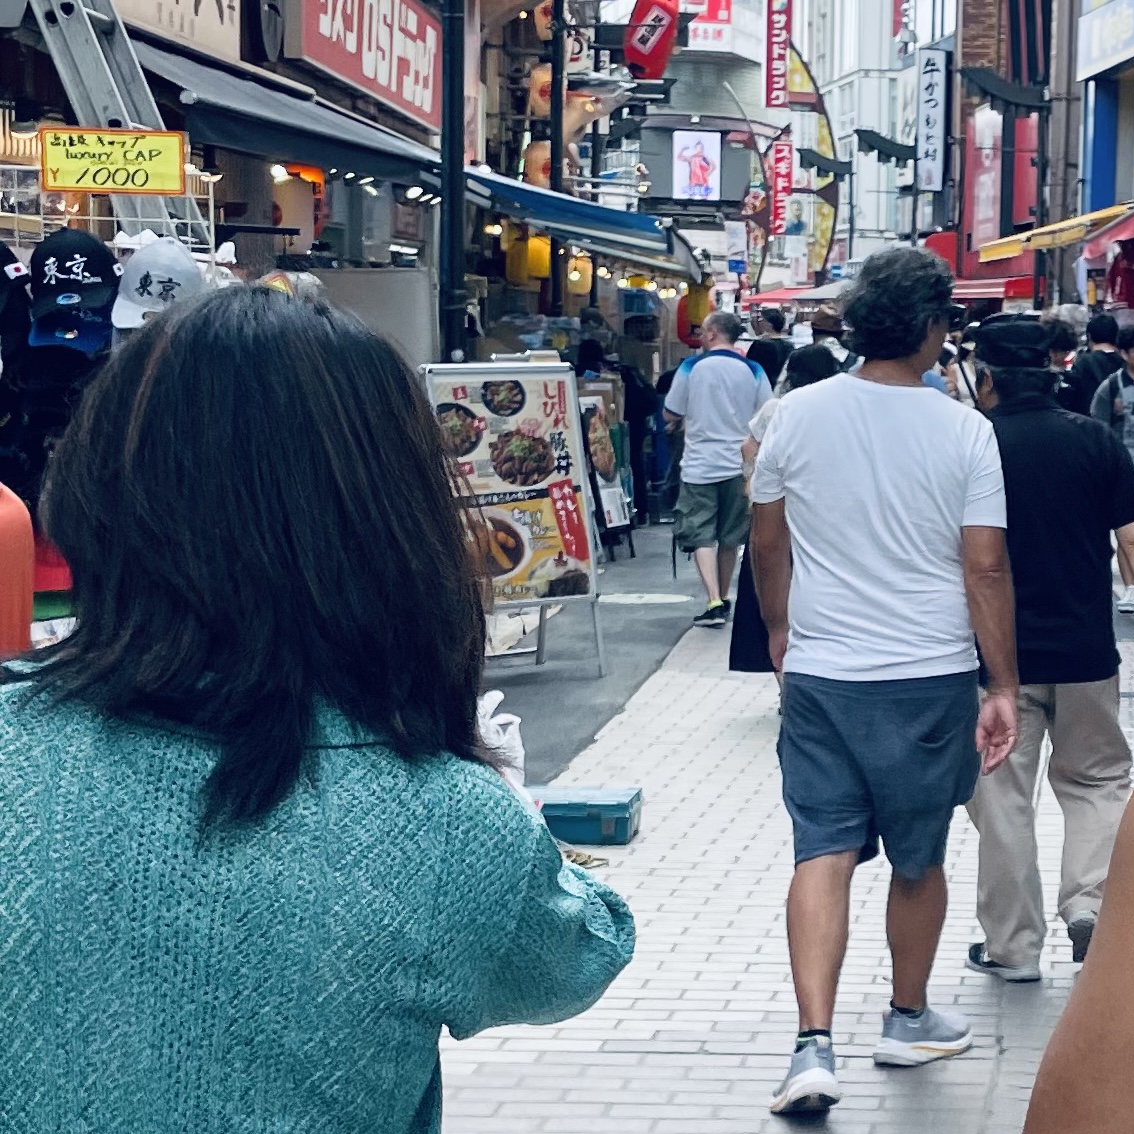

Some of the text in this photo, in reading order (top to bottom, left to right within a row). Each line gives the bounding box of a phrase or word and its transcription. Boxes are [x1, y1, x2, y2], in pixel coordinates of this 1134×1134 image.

[122, 149, 163, 162] CAP
[43, 253, 95, 285] 東京
[134, 271, 181, 302] 東京
